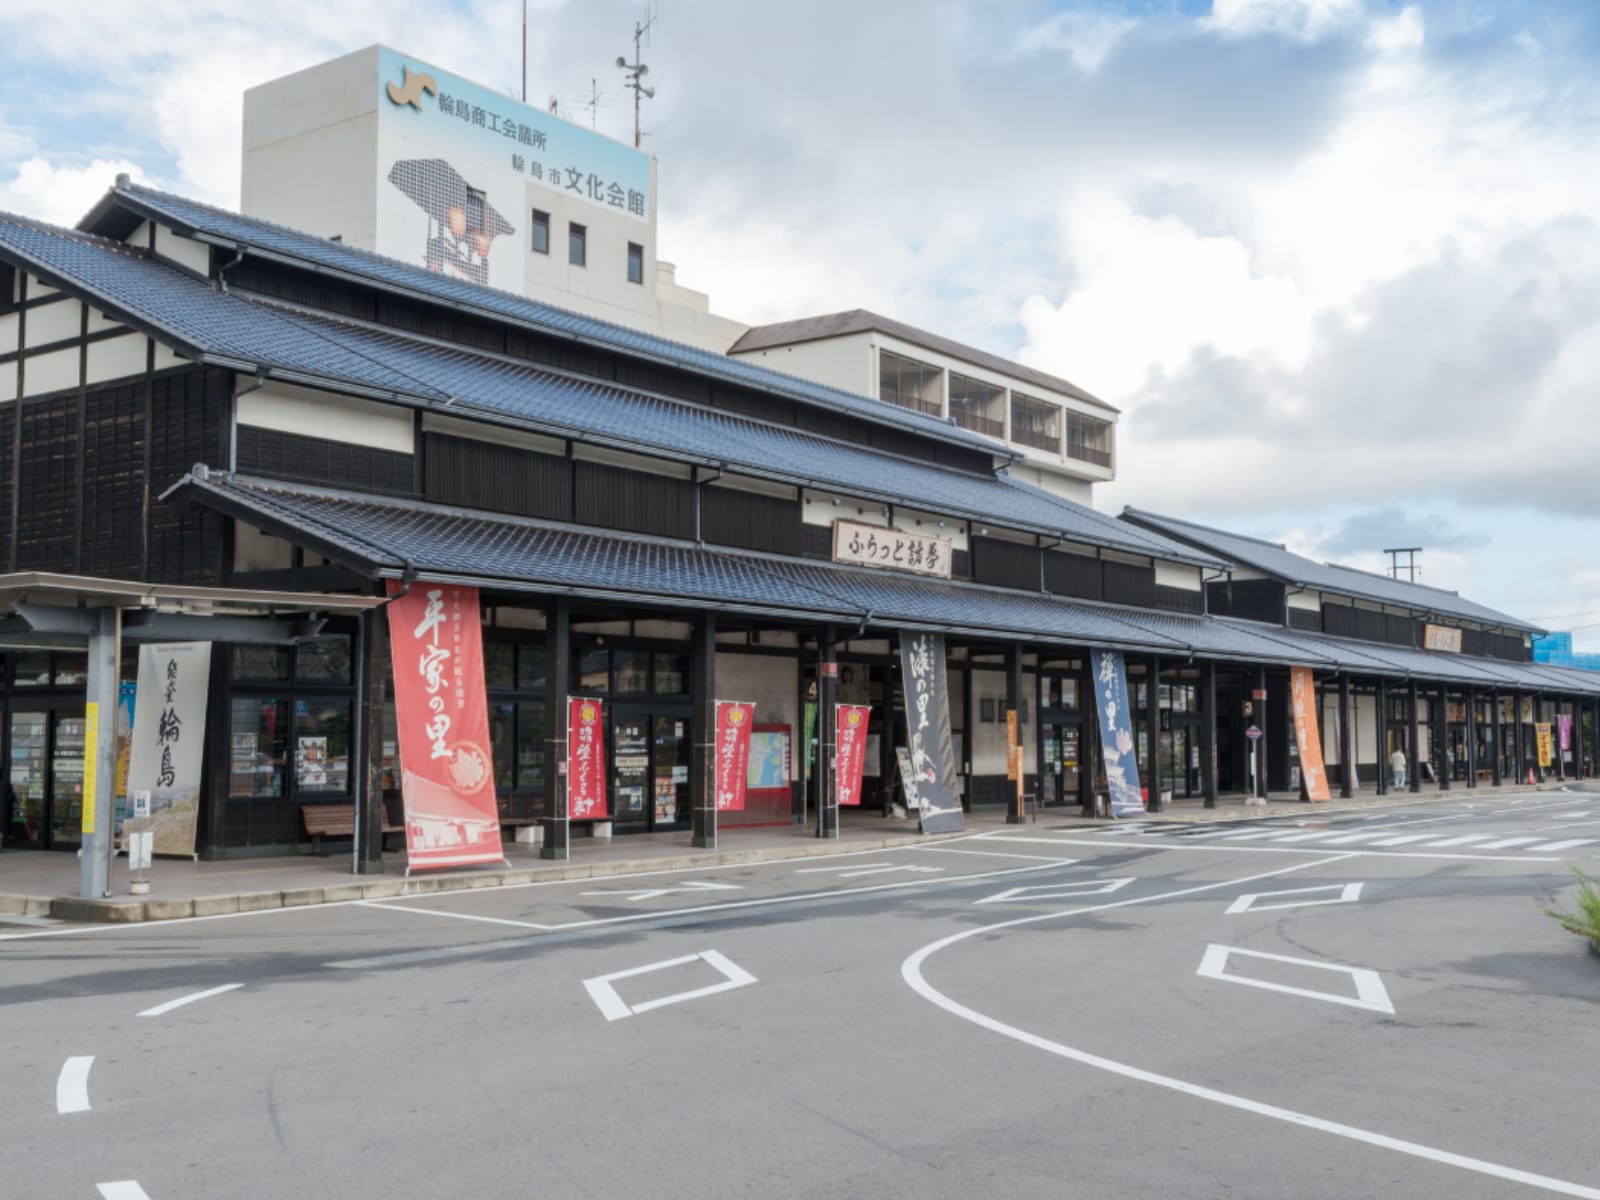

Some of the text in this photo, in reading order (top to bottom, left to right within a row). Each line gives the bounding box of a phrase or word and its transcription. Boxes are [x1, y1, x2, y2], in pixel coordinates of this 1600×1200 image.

[438, 92, 546, 153] 輪島商工会議所
[414, 589, 453, 760] 平家の里
[808, 681, 817, 697] 4
